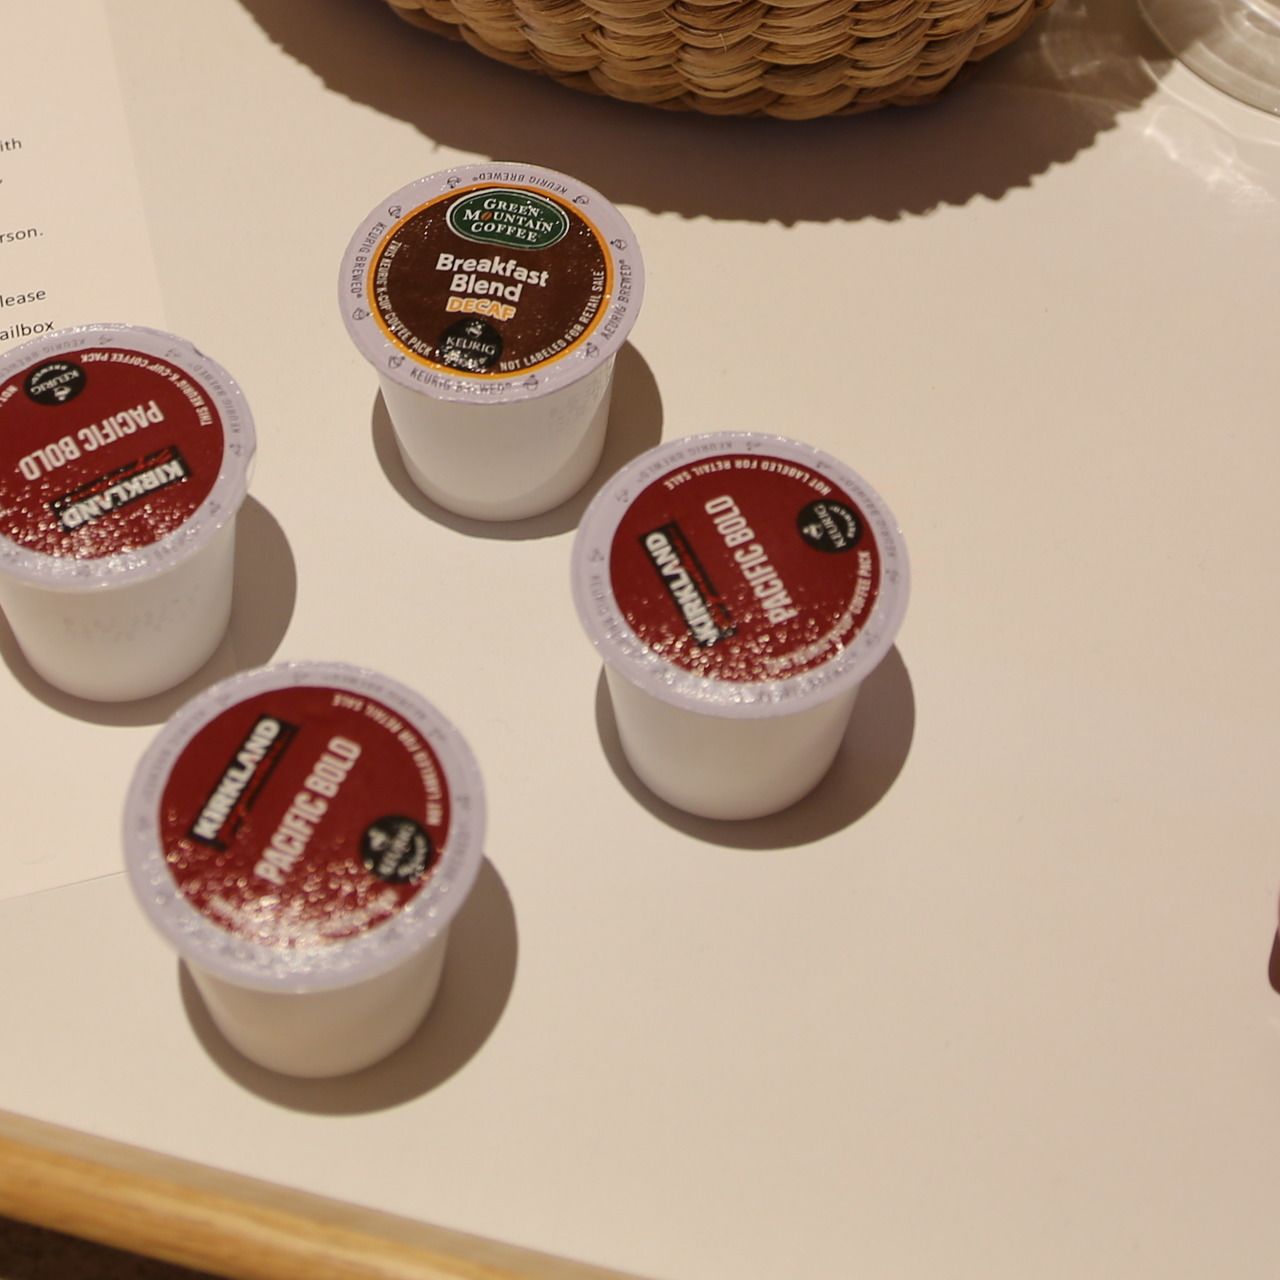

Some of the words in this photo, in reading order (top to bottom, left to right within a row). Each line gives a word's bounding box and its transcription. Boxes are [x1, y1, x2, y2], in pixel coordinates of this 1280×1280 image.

[529, 177, 568, 195] KEURIG
[483, 197, 540, 219] GREEN
[359, 222, 387, 254] KEURIG
[470, 221, 538, 243] COFFEE
[384, 241, 403, 257] THIS
[436, 253, 550, 288] Breakfast
[449, 273, 523, 302] Blend
[445, 296, 516, 321] DECAF
[500, 359, 521, 372] NOT
[523, 339, 567, 366] LABELED
[565, 325, 584, 343] FOR
[579, 293, 602, 324] RETAIL
[591, 270, 605, 292] SALE
[384, 312, 410, 342] COFFEE
[80, 352, 109, 364] PACK
[407, 336, 433, 358] PACK
[446, 335, 496, 357] KEURIG
[111, 353, 148, 368] COFFEE
[30, 369, 80, 396] KEURIG
[77, 400, 164, 453] PACIFIC
[196, 405, 214, 427] THIS
[18, 434, 81, 481] BOLD
[691, 459, 732, 478] RETAIL
[734, 459, 758, 470] FOR
[663, 471, 693, 492] SALE
[762, 460, 810, 485] LABELED
[62, 459, 184, 529] KIRKLAND
[809, 478, 832, 497] NOT
[703, 494, 756, 549] BOLD
[813, 503, 847, 550] KEURIG
[644, 531, 720, 647] KIRKLAND
[735, 543, 799, 625] PACIFIC
[192, 717, 281, 840] KIRKLAND
[253, 791, 329, 887] PACIFIC
[304, 735, 363, 799] BOLD
